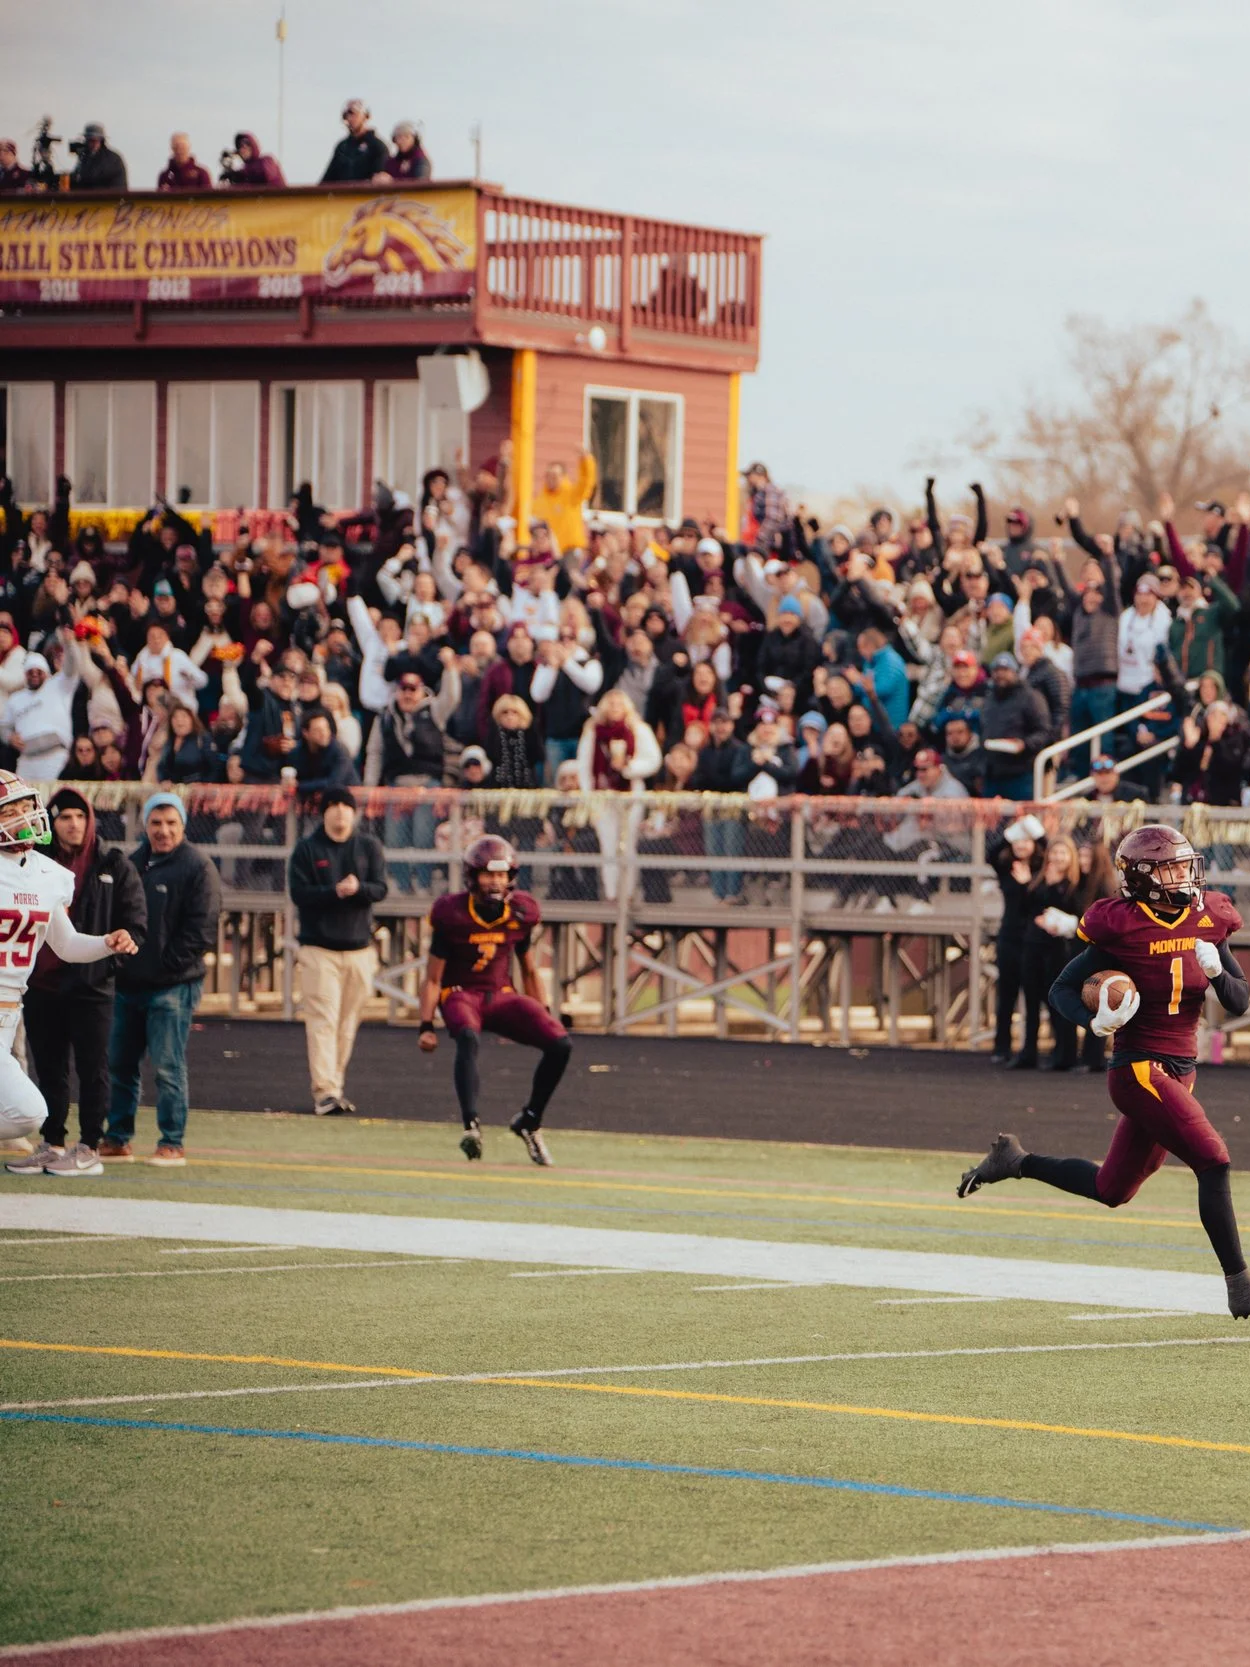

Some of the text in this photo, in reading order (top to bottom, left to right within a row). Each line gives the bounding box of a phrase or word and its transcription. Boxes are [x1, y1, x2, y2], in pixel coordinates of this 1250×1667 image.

[59, 242, 137, 270] STATE
[144, 236, 297, 269] CHAMPIONS
[13, 892, 39, 906] MORRIS
[472, 943, 497, 972] 7
[1168, 957, 1183, 1015] 1
